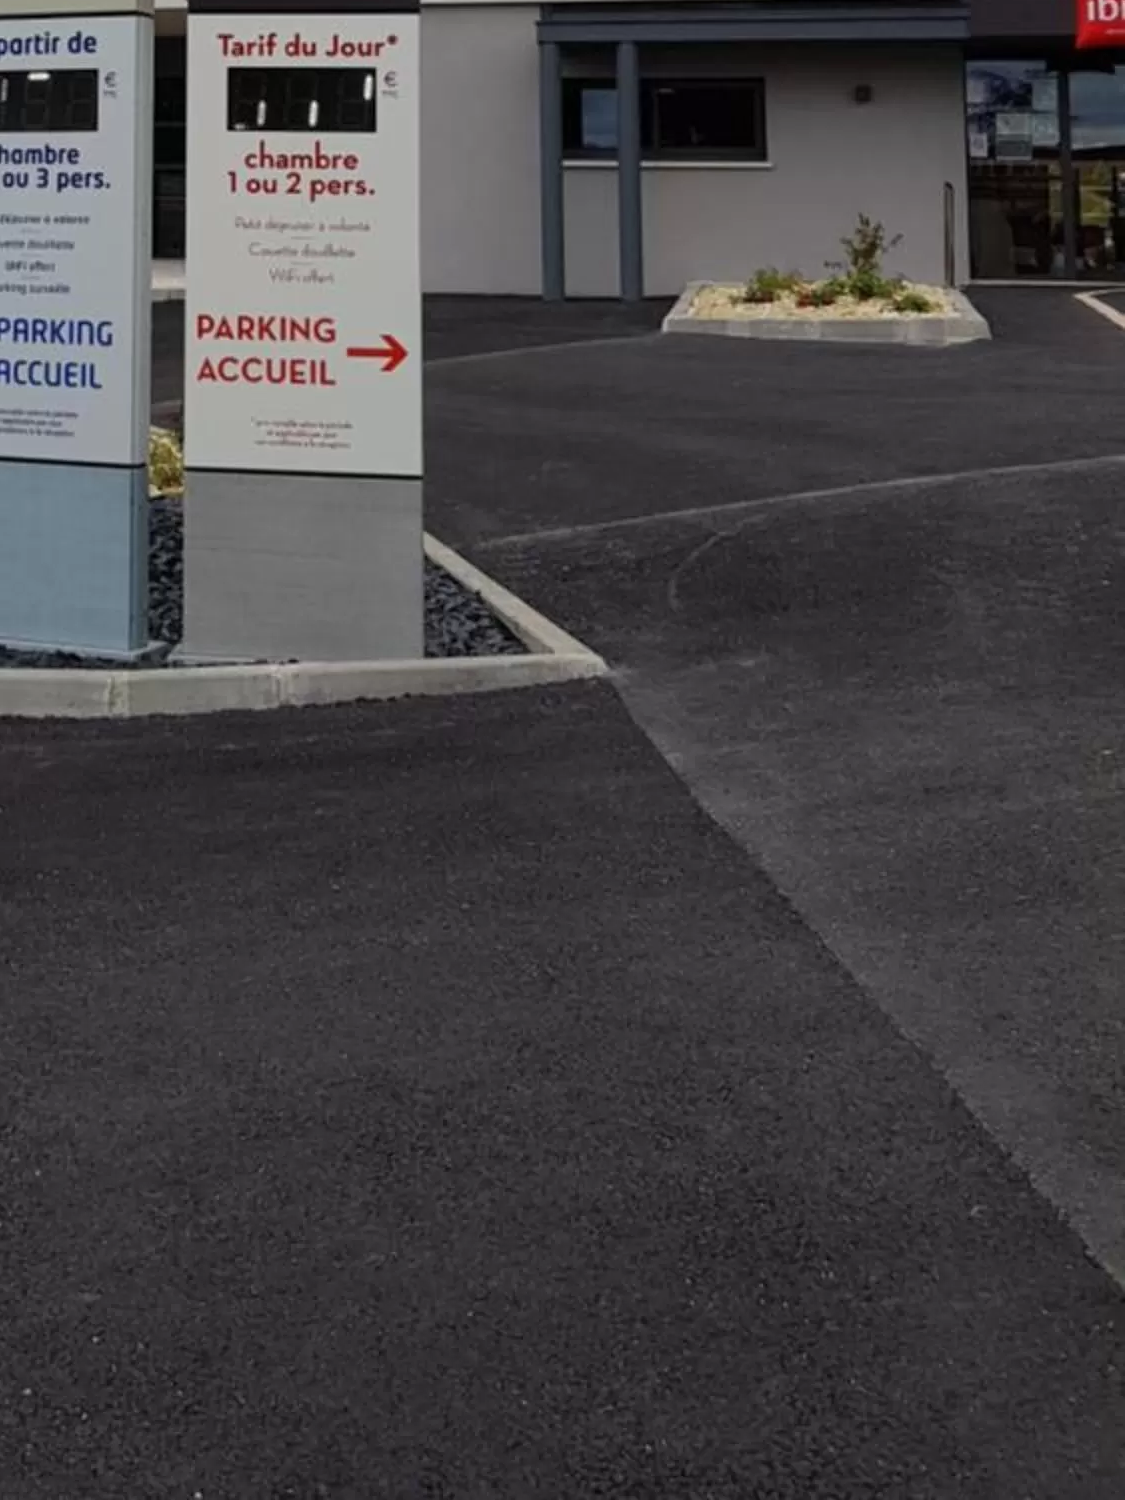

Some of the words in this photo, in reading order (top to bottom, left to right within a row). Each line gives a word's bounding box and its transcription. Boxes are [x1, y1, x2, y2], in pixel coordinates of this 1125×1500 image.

[67, 31, 97, 54] de
[216, 32, 277, 57] Tarif
[284, 33, 317, 57] du
[383, 70, 398, 88] €
[243, 140, 360, 170] chambre
[2, 172, 29, 189] ou
[36, 168, 49, 189] 3
[56, 171, 111, 192] pers.
[227, 171, 237, 193] 1
[245, 177, 277, 194] ou
[286, 172, 302, 194] 2
[309, 176, 376, 203] pers.
[196, 314, 337, 343] PARKING
[196, 356, 337, 386] ACCUEIL
